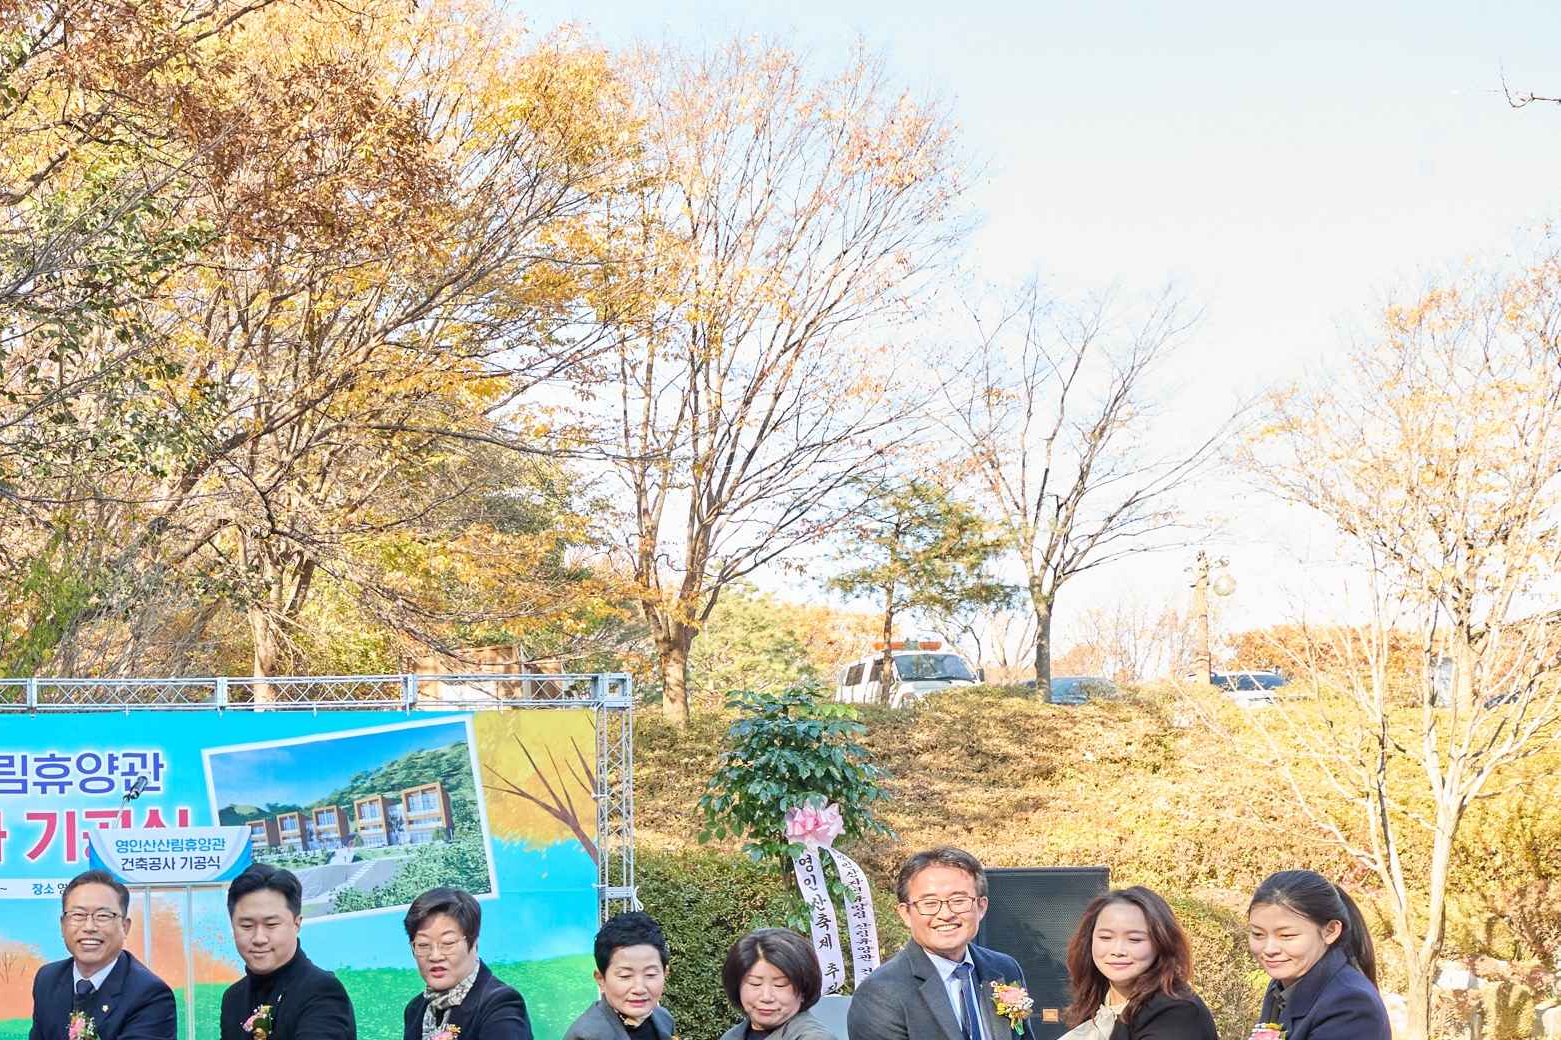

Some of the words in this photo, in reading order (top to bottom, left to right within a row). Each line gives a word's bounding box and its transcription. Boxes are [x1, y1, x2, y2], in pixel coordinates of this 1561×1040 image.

[115, 837, 227, 854] 영인산산림휴양관
[121, 857, 176, 872] 건축공사
[180, 855, 221, 871] 기공식
[31, 883, 55, 895] 장소
[798, 854, 833, 951] 영인산축제
